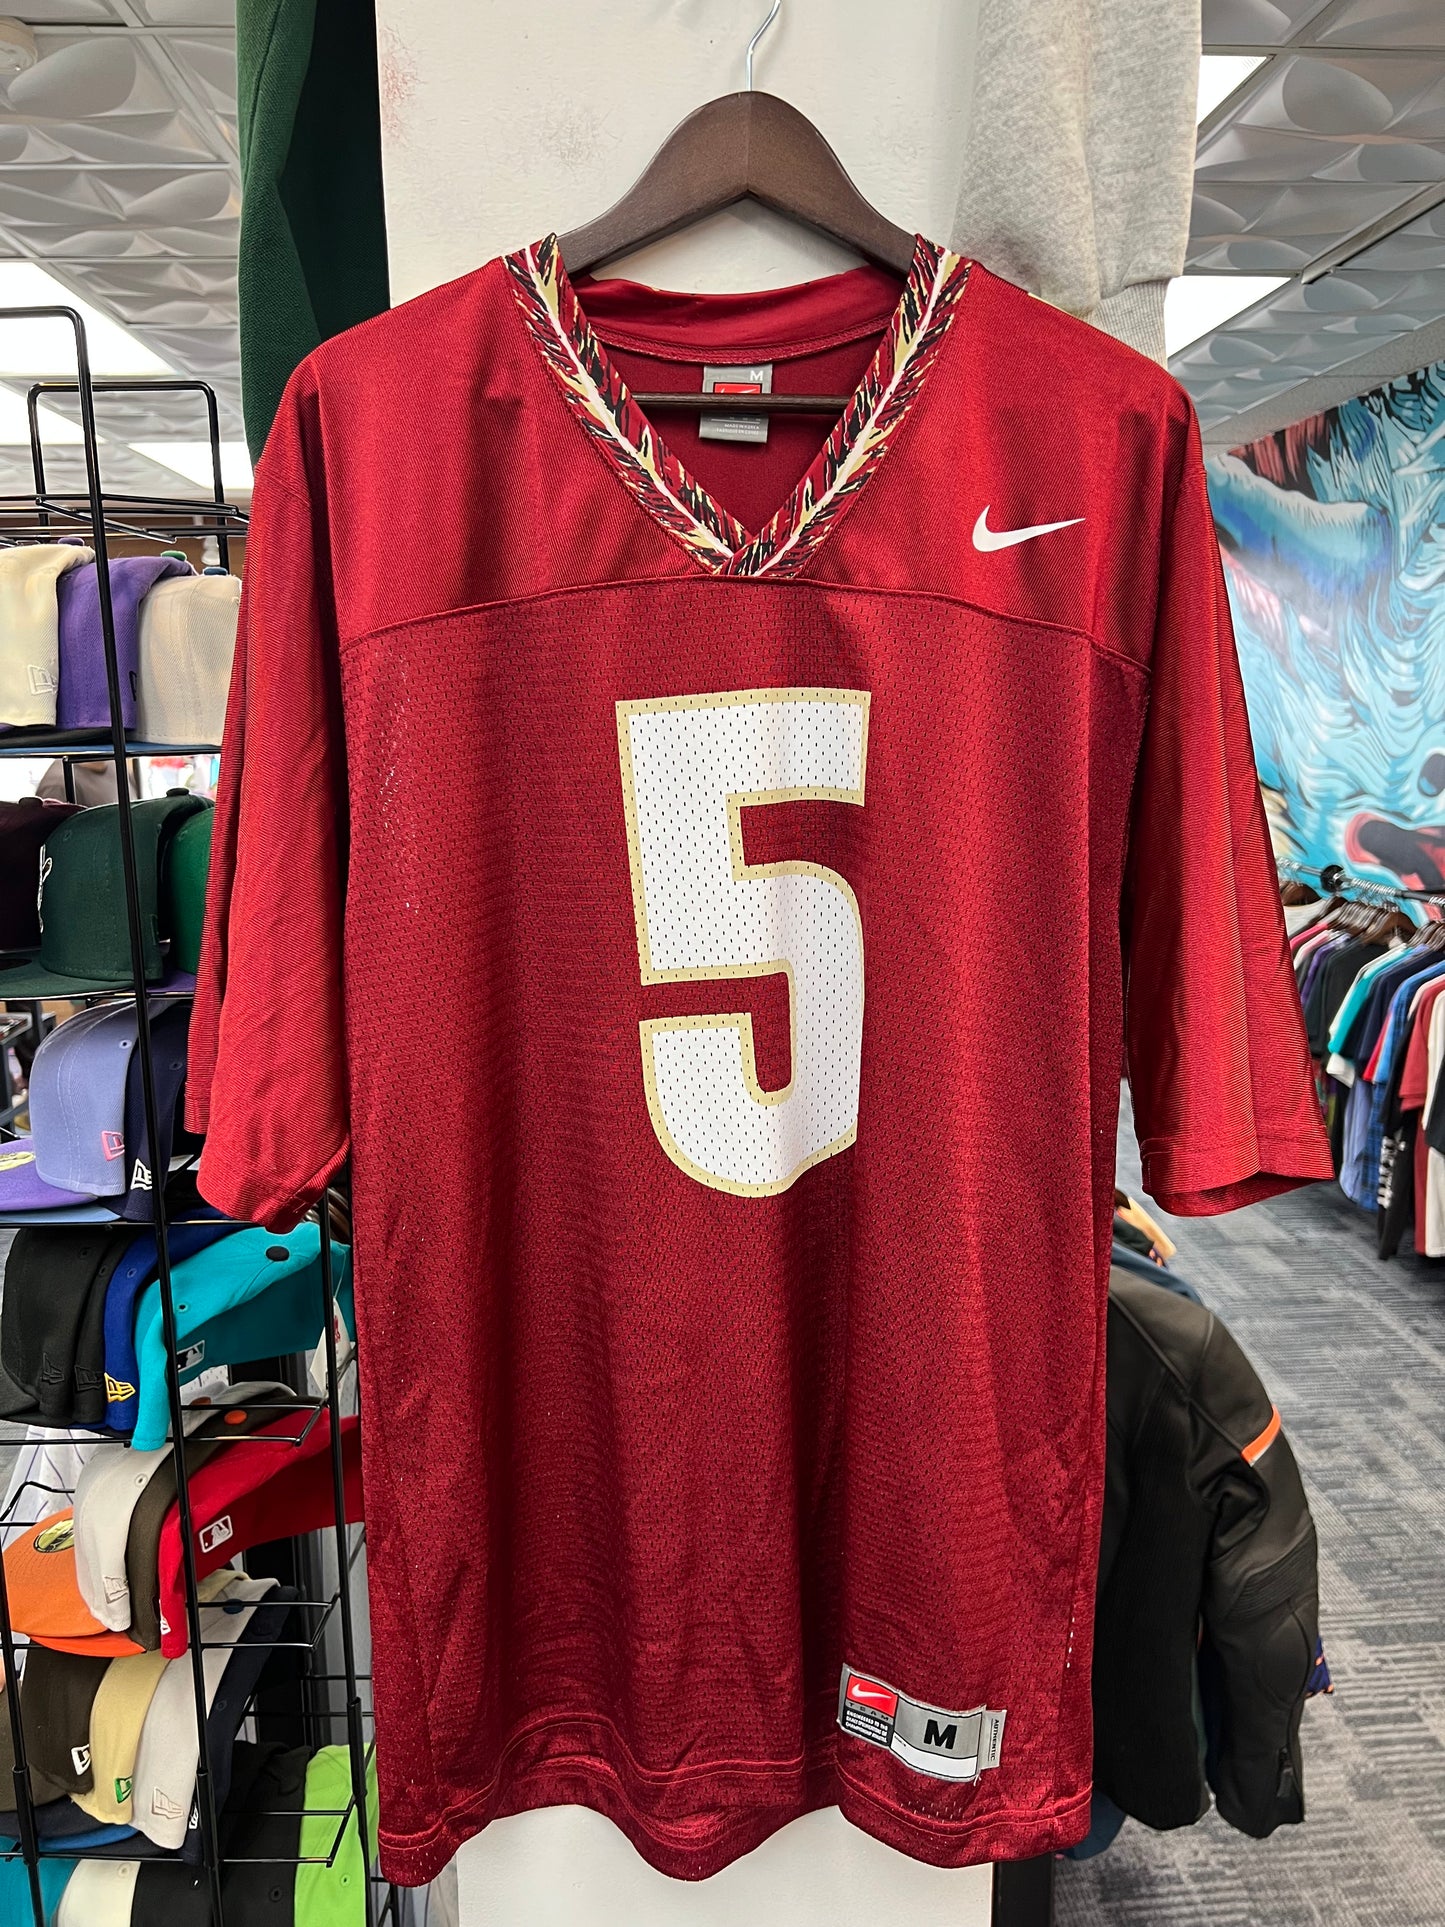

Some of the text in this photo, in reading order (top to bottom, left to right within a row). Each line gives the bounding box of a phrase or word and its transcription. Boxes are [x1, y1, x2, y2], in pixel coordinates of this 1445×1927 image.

[750, 370, 764, 381] M
[615, 687, 871, 1198] 5
[848, 1702, 889, 1721] TEAM
[923, 1718, 958, 1750] M
[990, 1719, 1000, 1762] AUTHENTIC
